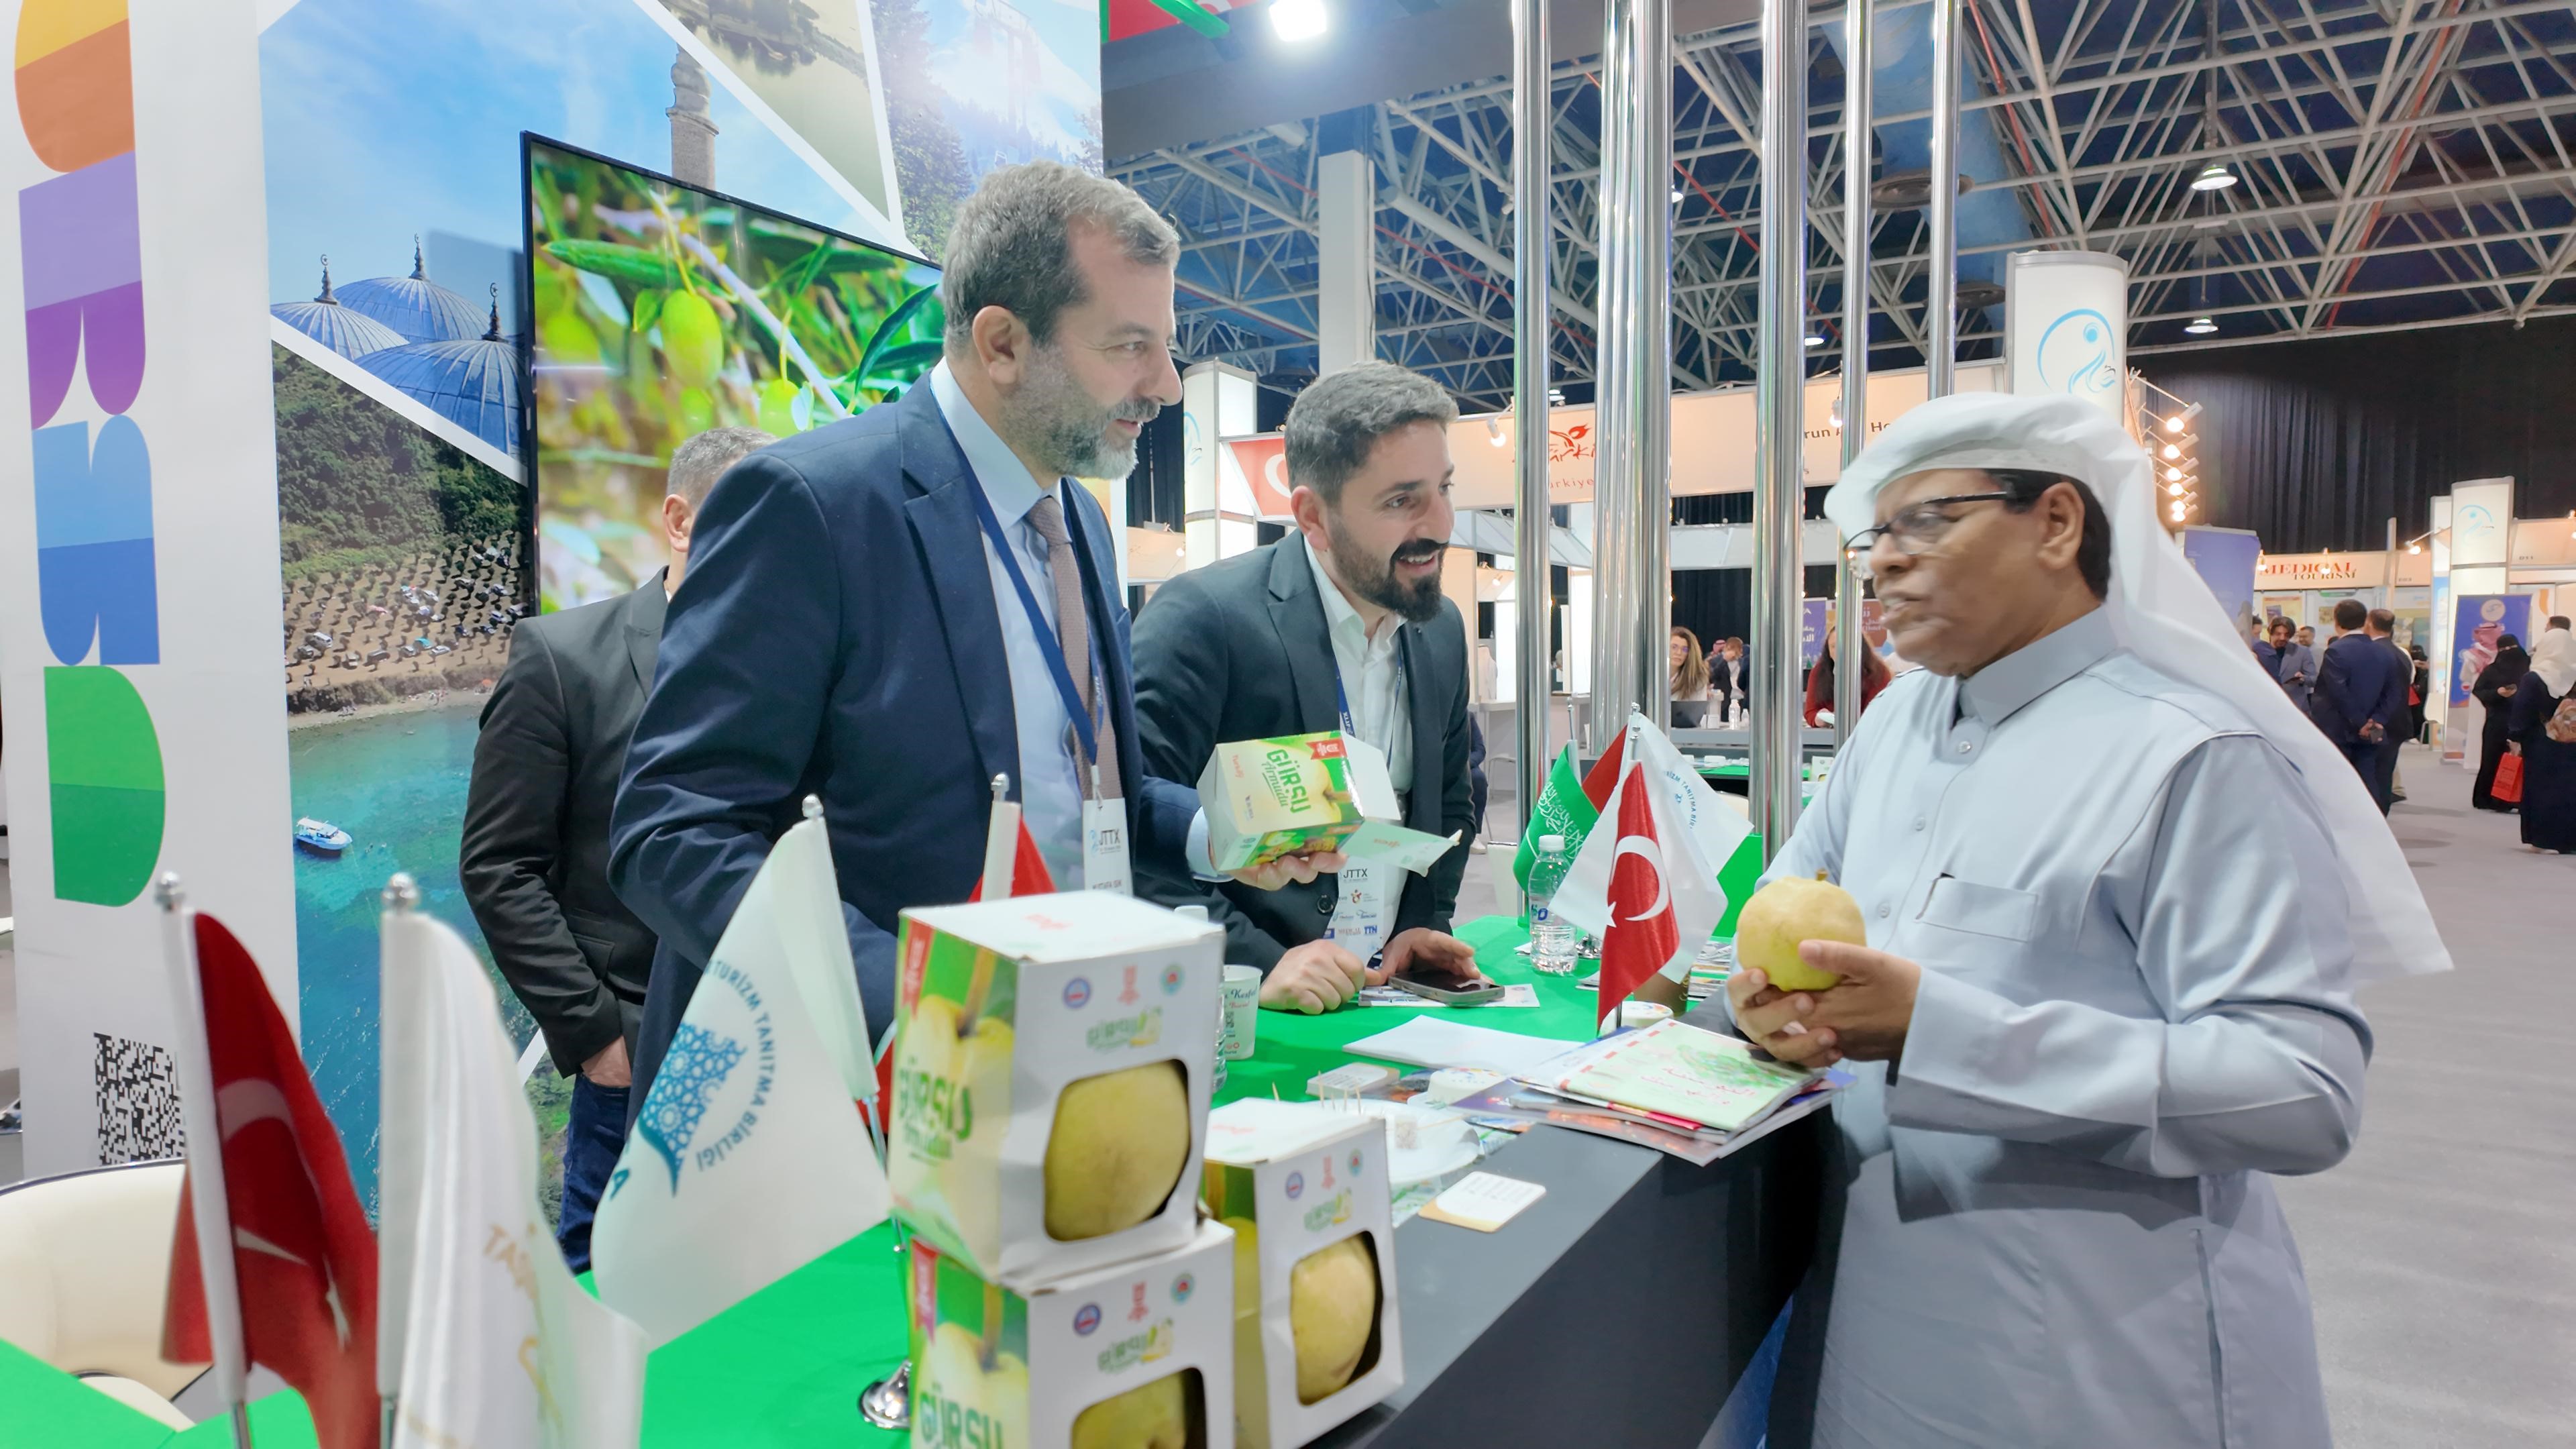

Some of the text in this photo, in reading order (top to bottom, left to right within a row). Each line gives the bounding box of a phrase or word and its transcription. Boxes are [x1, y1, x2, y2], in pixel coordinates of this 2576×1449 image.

[2292, 572, 2356, 580] TOURISM
[1099, 828, 1120, 845] JTTX
[1343, 868, 1368, 878] JTTX
[750, 1012, 775, 1106] TANITMA
